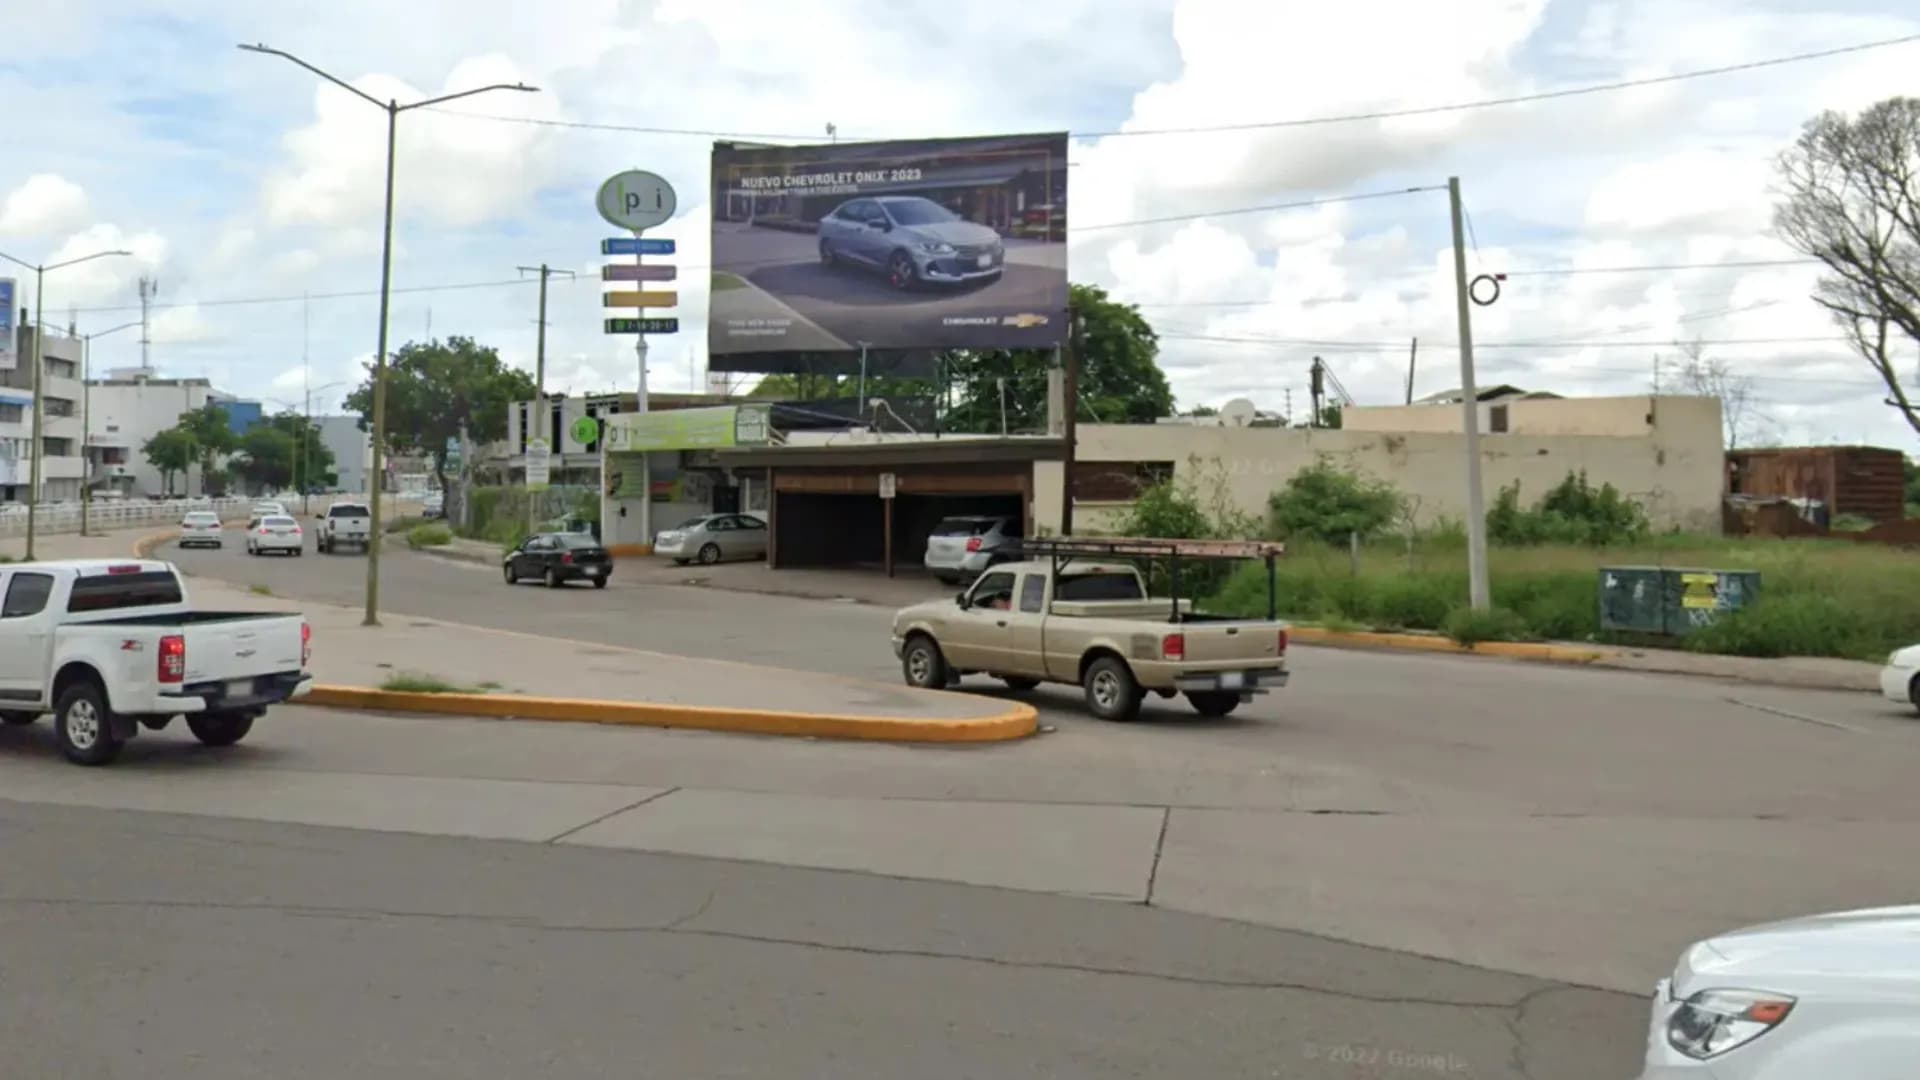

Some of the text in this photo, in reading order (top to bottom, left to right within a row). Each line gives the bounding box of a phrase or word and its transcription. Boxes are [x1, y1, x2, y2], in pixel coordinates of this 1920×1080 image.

[741, 175, 781, 188] NUEVO
[784, 171, 853, 187] CHEVROLET
[890, 168, 922, 182] 2023
